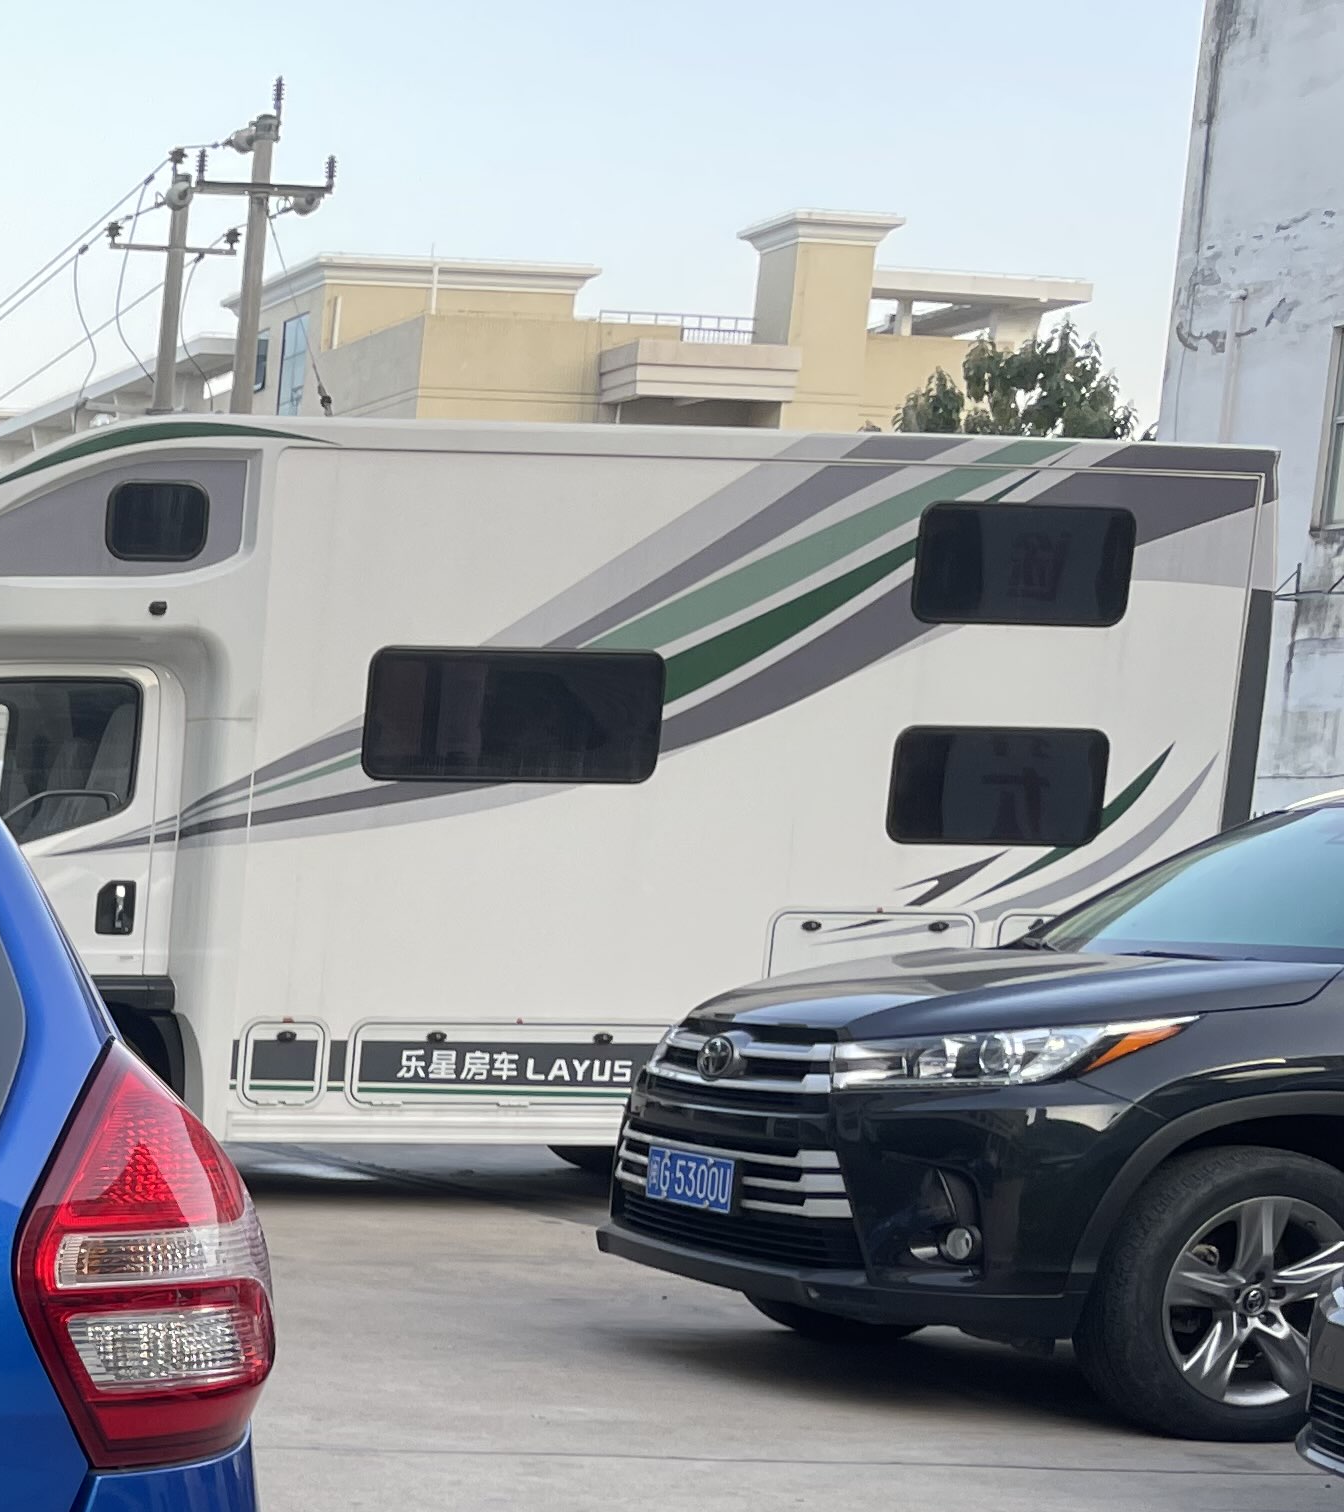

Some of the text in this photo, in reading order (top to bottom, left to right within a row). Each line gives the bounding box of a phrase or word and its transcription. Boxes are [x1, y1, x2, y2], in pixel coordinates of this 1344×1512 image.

[396, 1048, 633, 1083] 乐星房车 LAYUS
